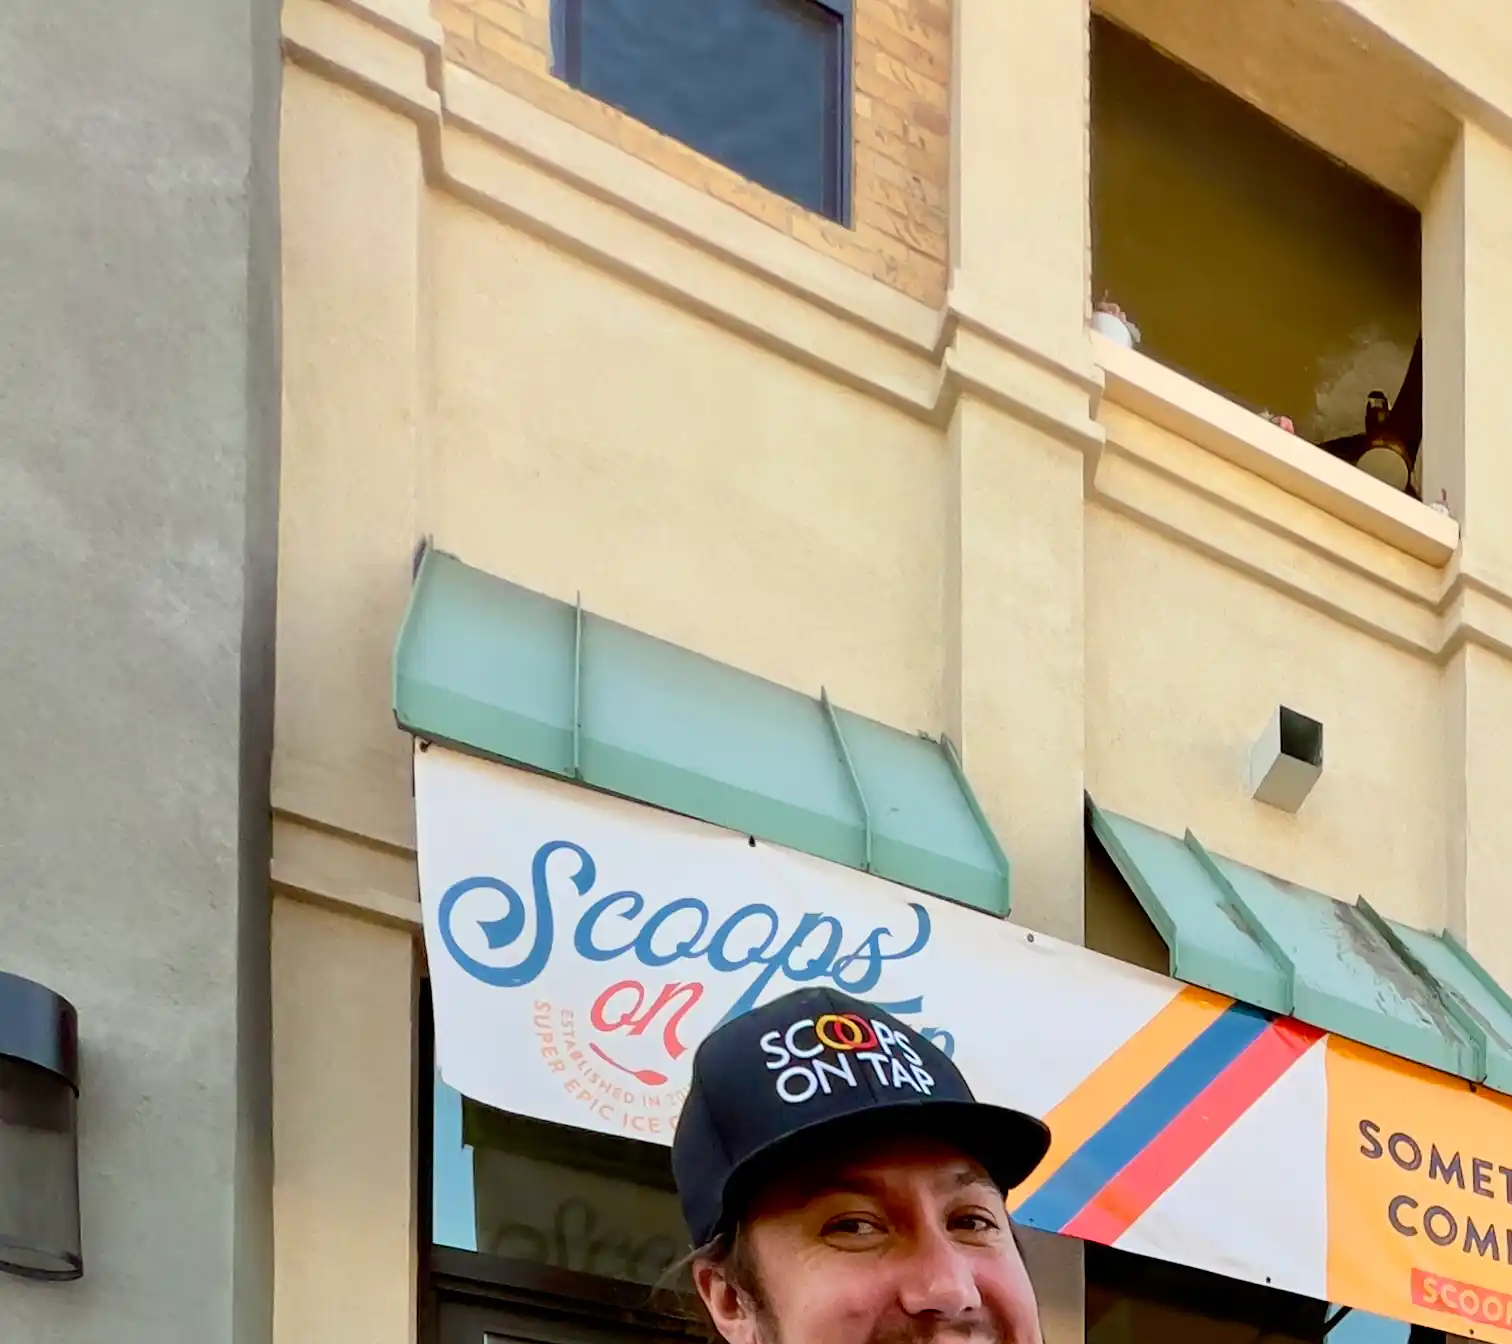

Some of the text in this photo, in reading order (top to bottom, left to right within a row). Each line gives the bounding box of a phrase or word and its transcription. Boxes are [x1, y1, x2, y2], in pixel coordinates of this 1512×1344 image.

[438, 840, 931, 1035] Scoops
[560, 1008, 635, 1104] ESTABLISHED
[590, 979, 704, 1060] on
[760, 1013, 924, 1070] SCOOPS
[533, 999, 661, 1133] SUPER EPIC ICE
[642, 1093, 662, 1107] IN
[776, 1052, 935, 1103] ON TAP
